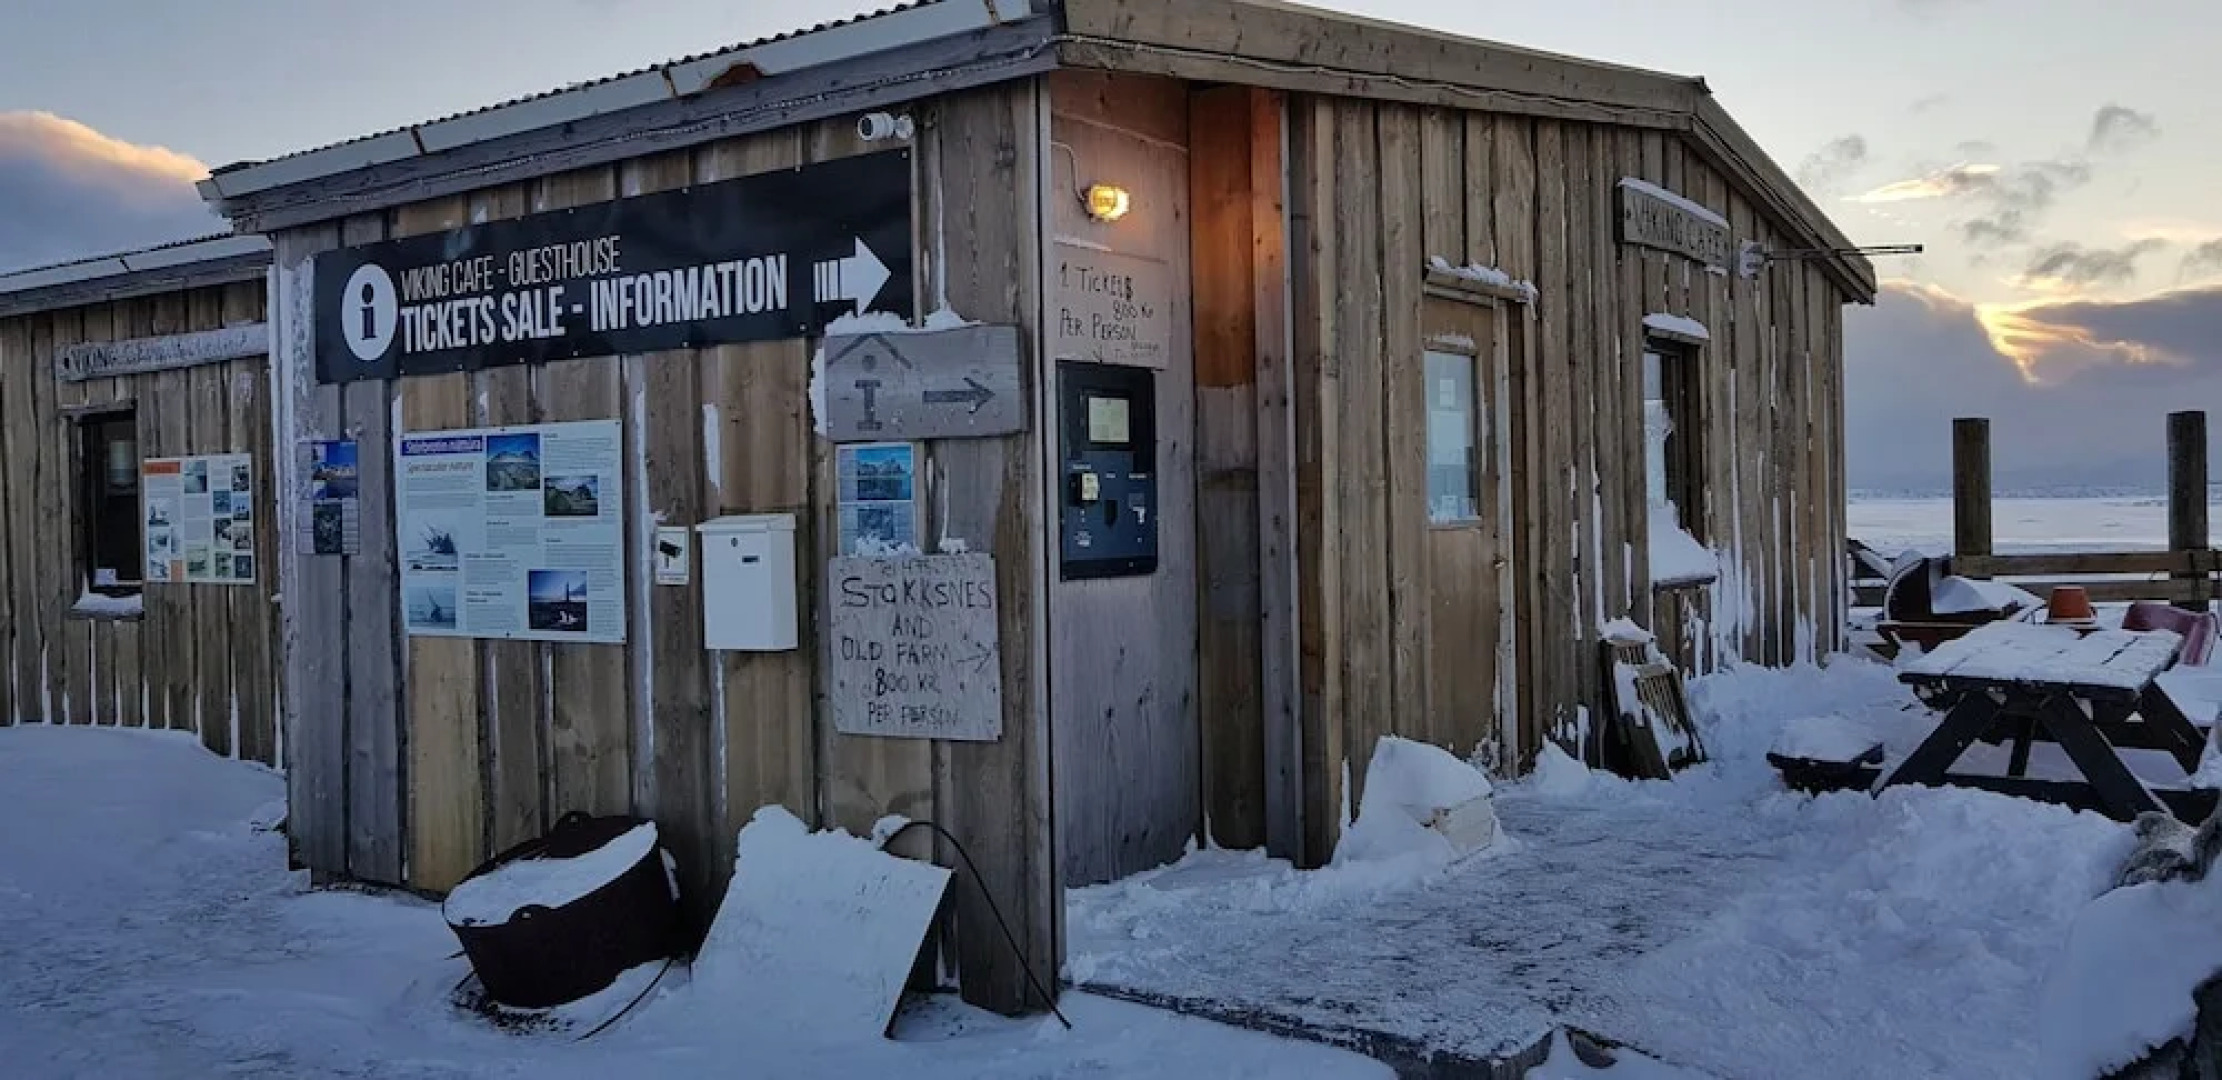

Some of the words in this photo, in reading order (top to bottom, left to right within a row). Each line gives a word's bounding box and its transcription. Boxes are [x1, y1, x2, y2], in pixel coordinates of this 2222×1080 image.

[1632, 193, 1683, 245] VIKING
[1686, 216, 1723, 260] CAFE
[400, 264, 450, 301] VIKING
[452, 255, 494, 295] CAFE
[508, 235, 621, 287] GUESTHOUSE
[400, 295, 497, 354] TICKETS
[501, 286, 567, 343] SALE
[590, 252, 788, 333] INFORMATION
[1060, 306, 1084, 338] PER
[1092, 312, 1136, 341] PERSON
[892, 614, 932, 639] AND
[841, 635, 883, 661] OLD
[897, 642, 949, 666] FARM
[875, 667, 910, 696] 800
[868, 701, 893, 727] PER
